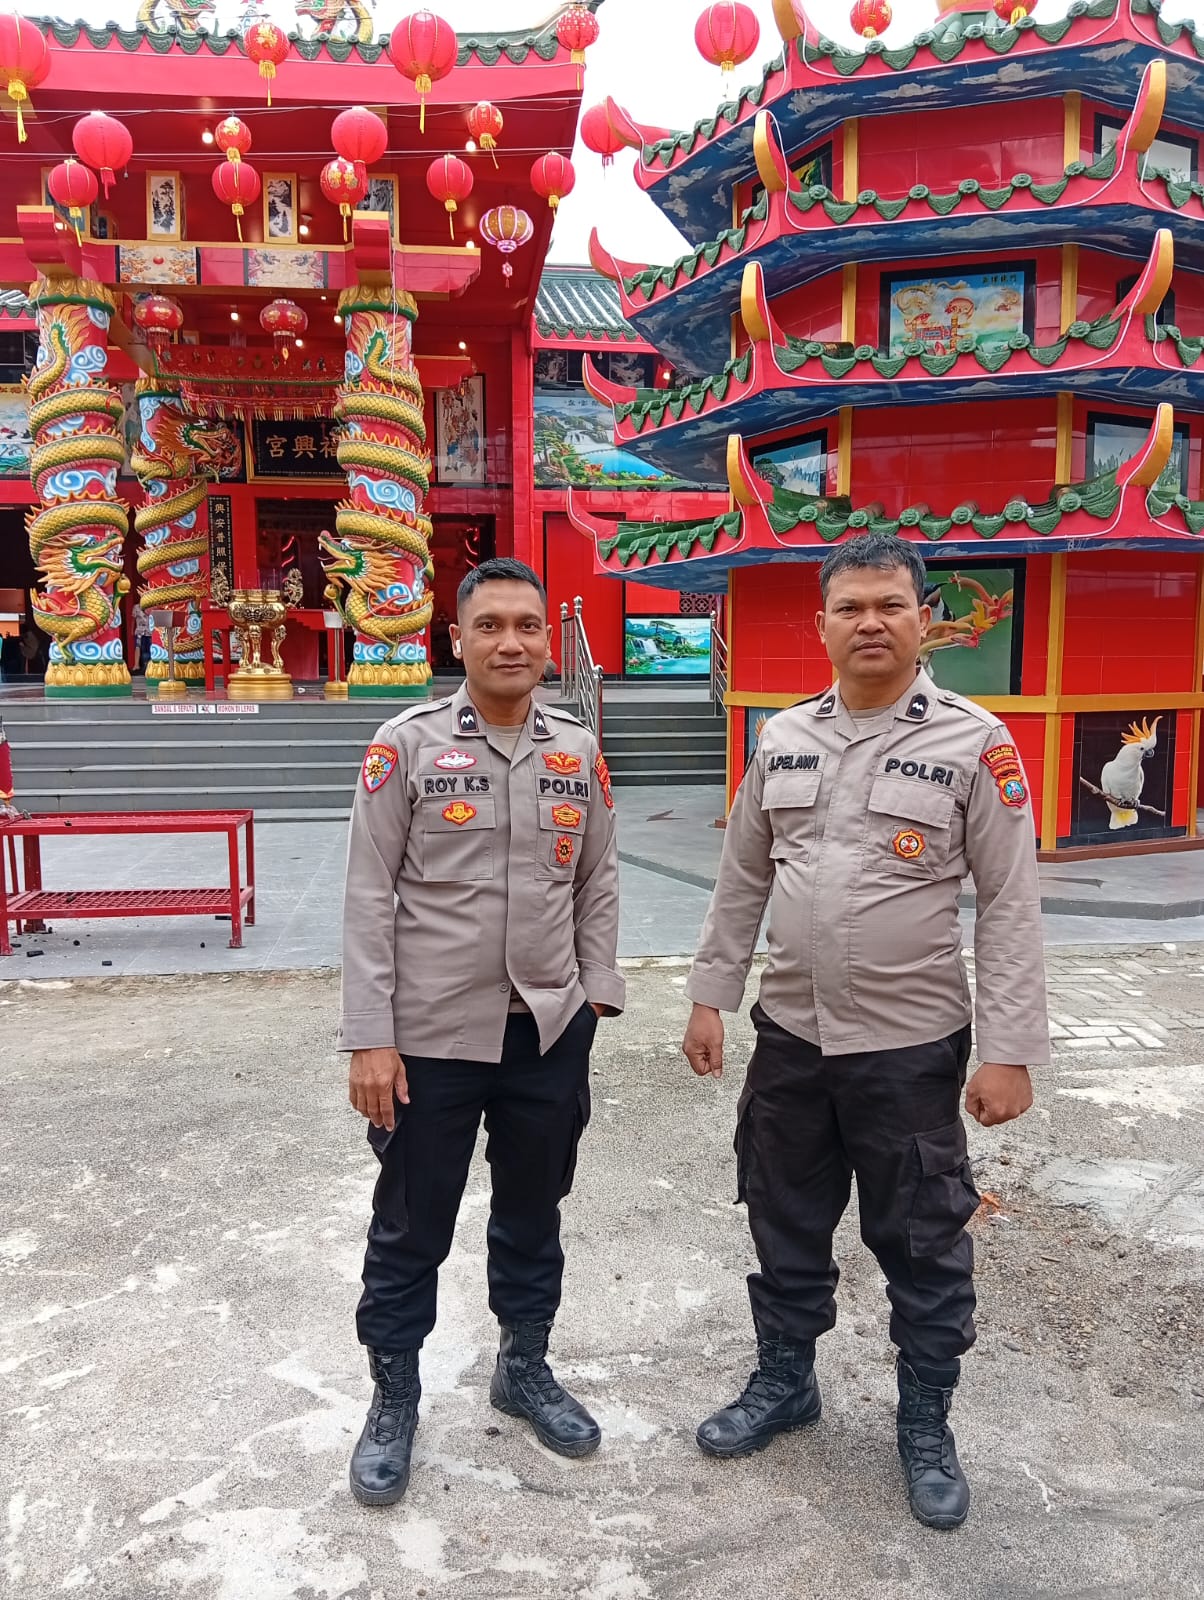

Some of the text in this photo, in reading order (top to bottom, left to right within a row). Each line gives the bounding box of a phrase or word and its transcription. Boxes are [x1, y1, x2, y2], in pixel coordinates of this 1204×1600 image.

[884, 757, 954, 786] POLRI
[424, 776, 490, 794] ROY K.S
[539, 778, 589, 798] POLRI
